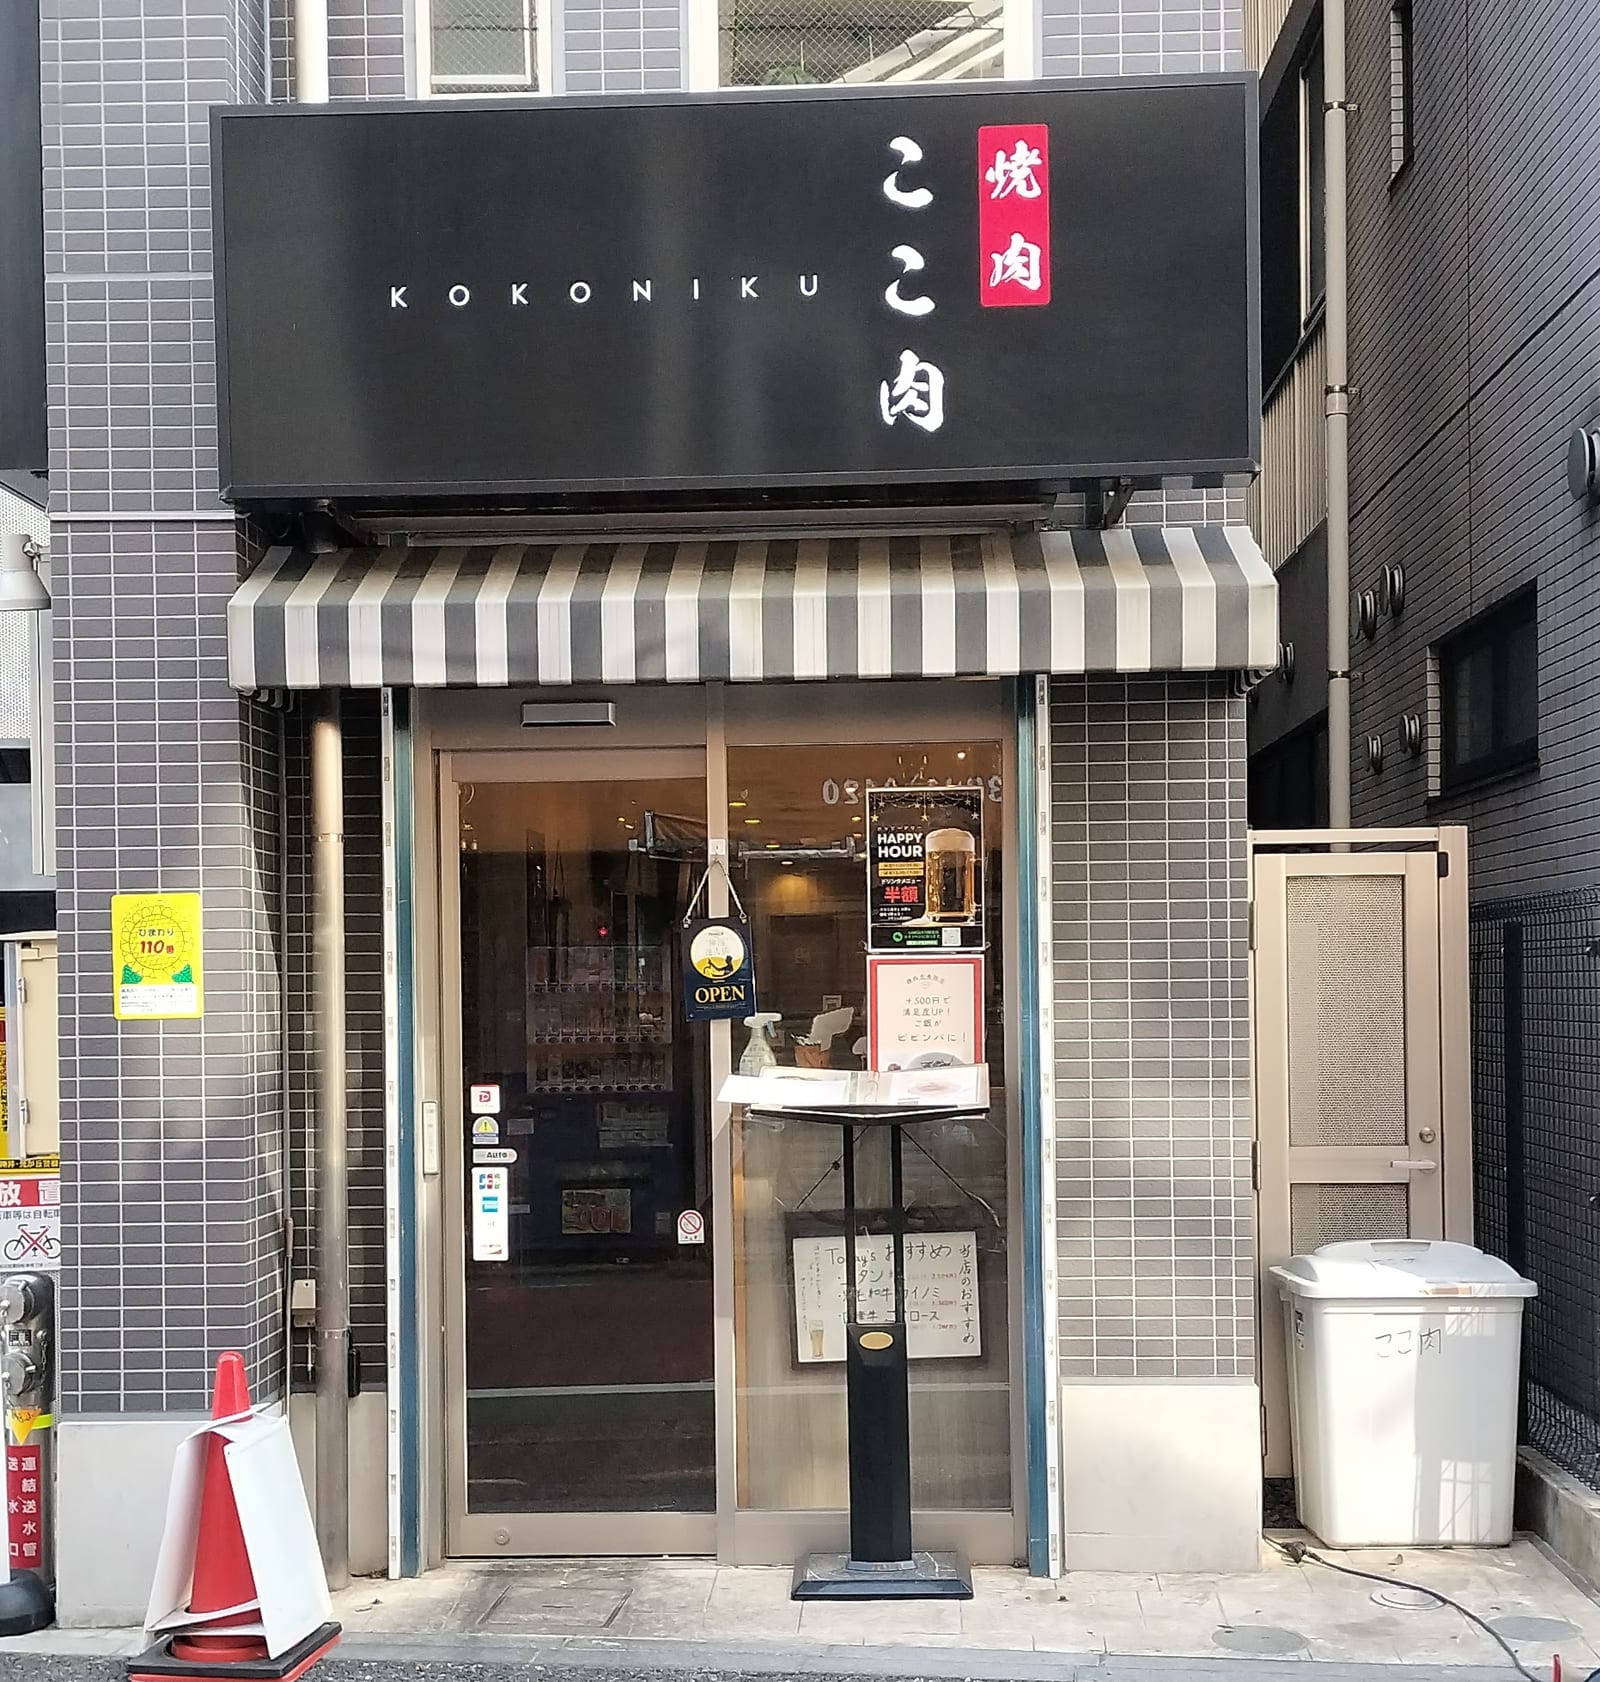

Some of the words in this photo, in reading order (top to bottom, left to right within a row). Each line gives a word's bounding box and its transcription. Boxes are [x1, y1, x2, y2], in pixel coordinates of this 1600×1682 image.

[986, 140, 1042, 291] 焼肉
[390, 275, 818, 309] KOKONIKU
[880, 136, 945, 433] ここ肉
[878, 832, 923, 845] HAPPY
[878, 845, 923, 858] HOUR
[884, 886, 919, 903] 半額
[138, 928, 175, 937] ひまわり
[695, 985, 745, 1004] OPEN
[825, 1247, 876, 1267] Toay's
[959, 1244, 976, 1345] 当店のおすすめ
[1375, 1327, 1441, 1358] ここ肉
